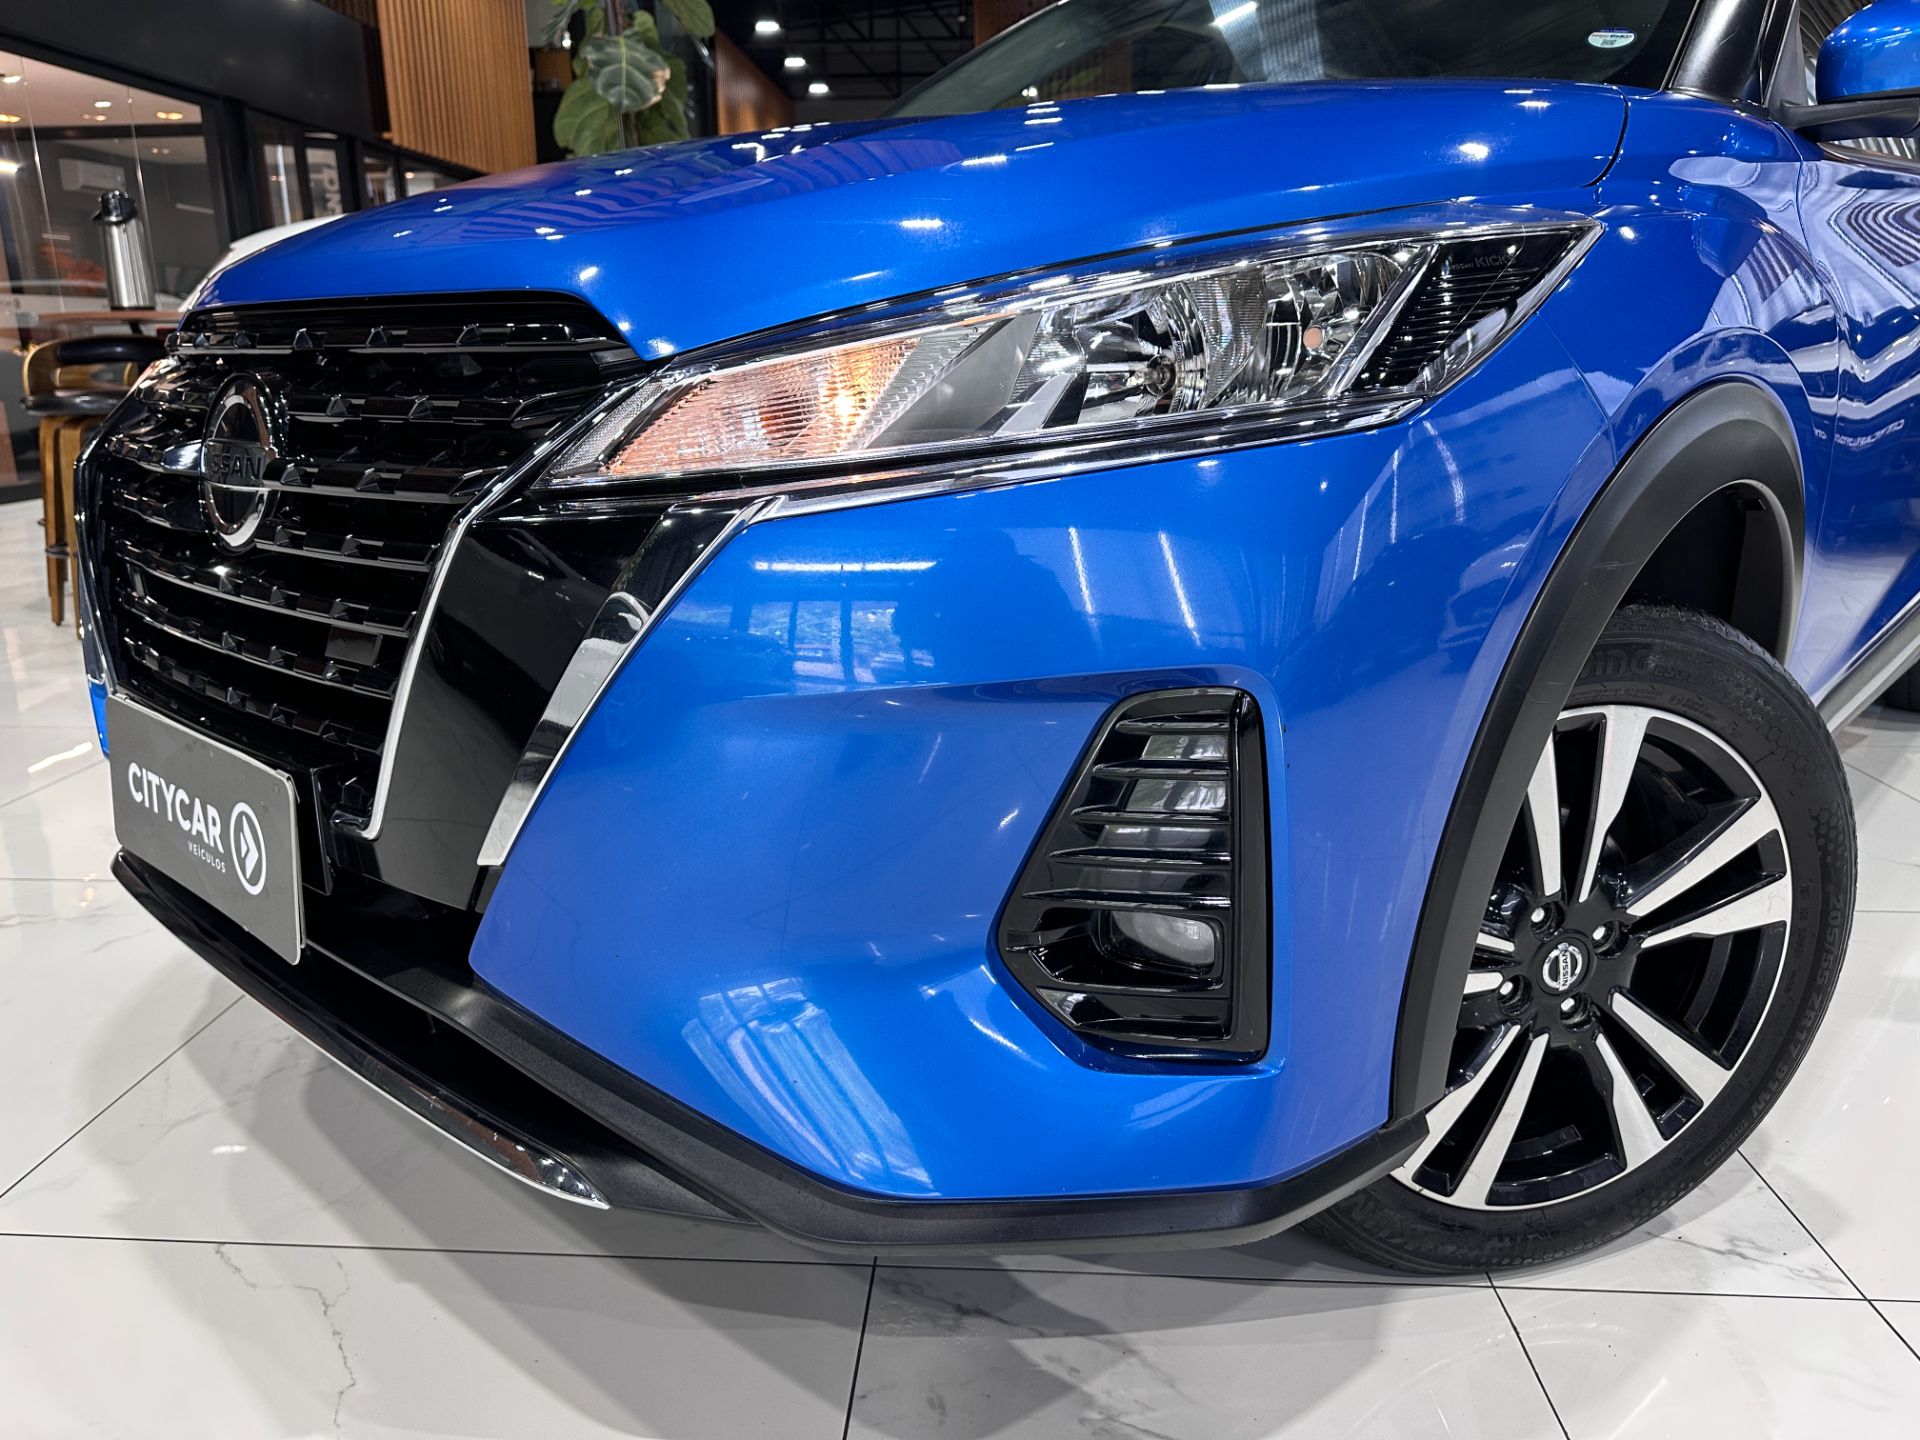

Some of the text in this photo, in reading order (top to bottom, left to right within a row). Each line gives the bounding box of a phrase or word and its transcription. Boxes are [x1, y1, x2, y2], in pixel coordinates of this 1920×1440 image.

[127, 761, 225, 854] CITYCAR
[1561, 949, 1569, 987] NISSAN
[1817, 892, 1844, 985] 205/55
[1790, 991, 1823, 1058] ZR17
[1750, 1062, 1789, 1119] 91W
